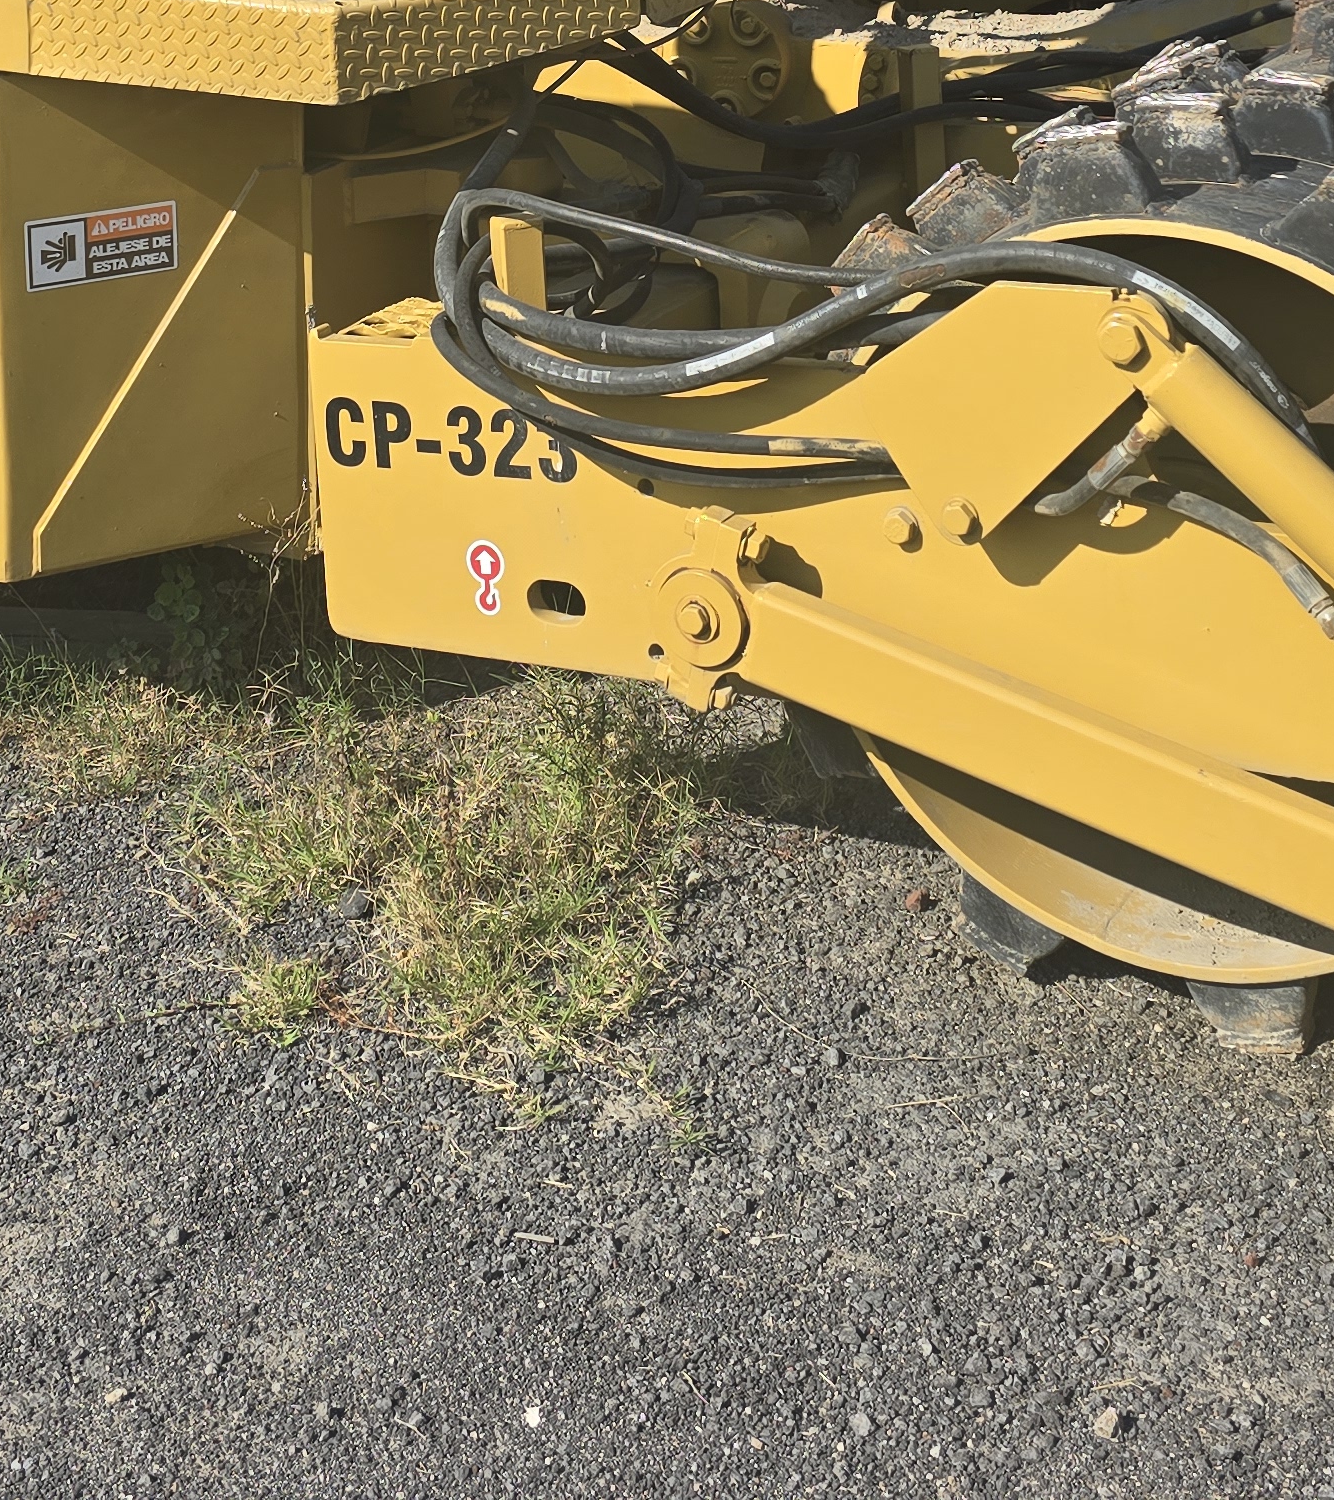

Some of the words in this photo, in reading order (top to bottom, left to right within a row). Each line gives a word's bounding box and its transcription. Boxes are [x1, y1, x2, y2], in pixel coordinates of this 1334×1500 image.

[108, 211, 170, 233] PELIGRO
[88, 237, 150, 259] ALEJESE
[152, 235, 172, 249] DE
[92, 257, 129, 274] ESTA
[131, 252, 169, 268] AREA
